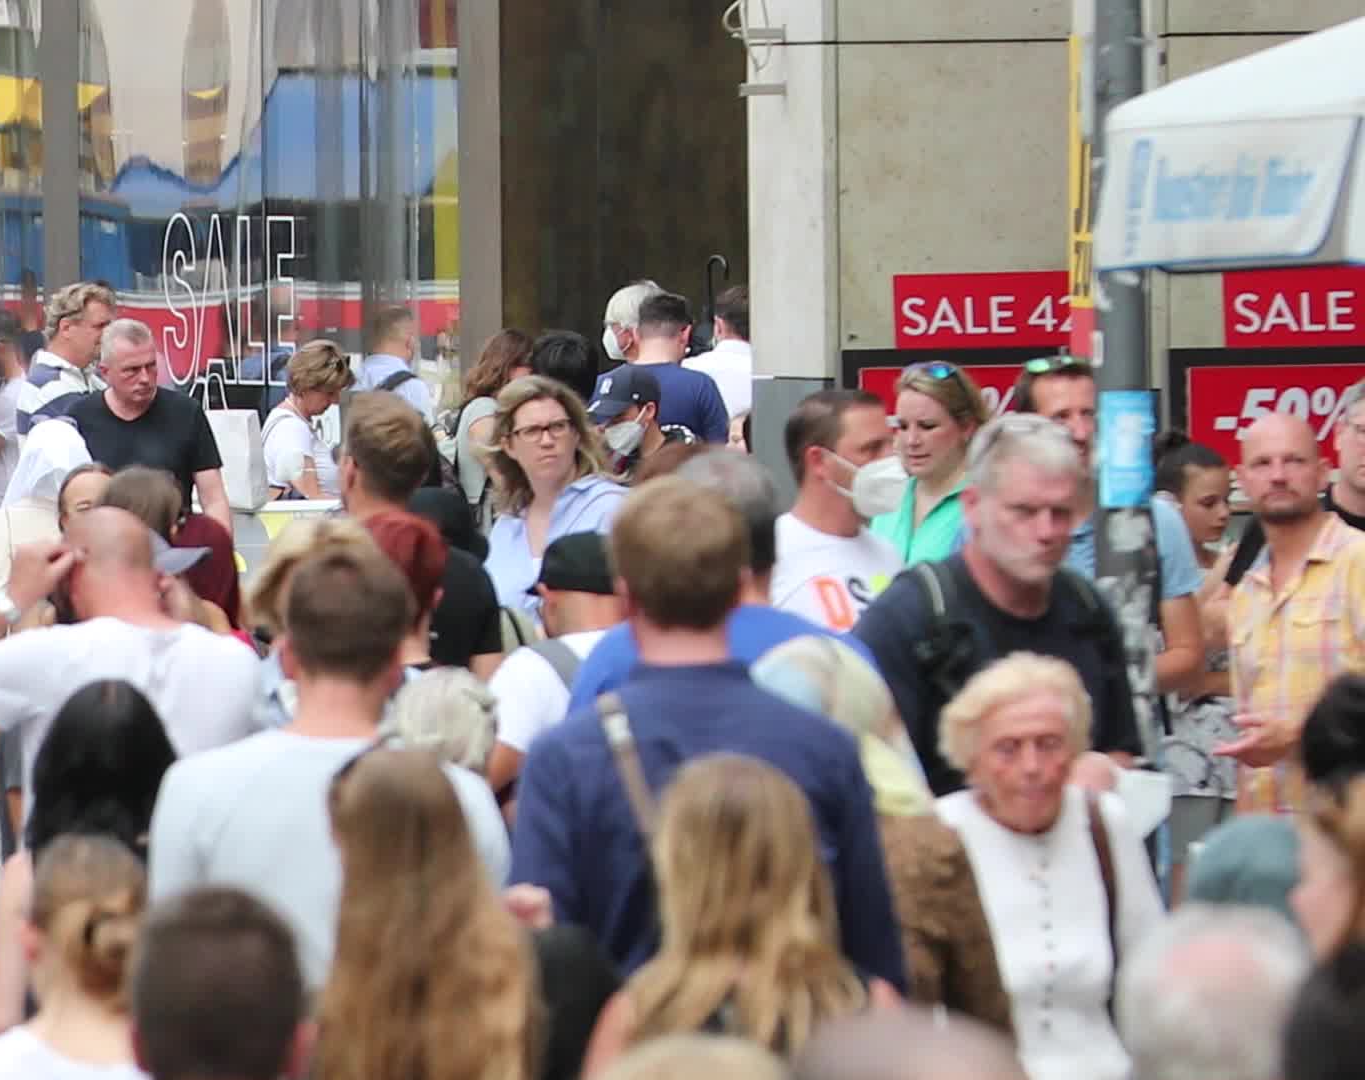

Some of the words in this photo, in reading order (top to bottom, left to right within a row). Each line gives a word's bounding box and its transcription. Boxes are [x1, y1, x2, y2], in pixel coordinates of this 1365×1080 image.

[162, 213, 296, 386] SALE
[901, 296, 1016, 336] SALE
[1234, 290, 1356, 334] SALE
